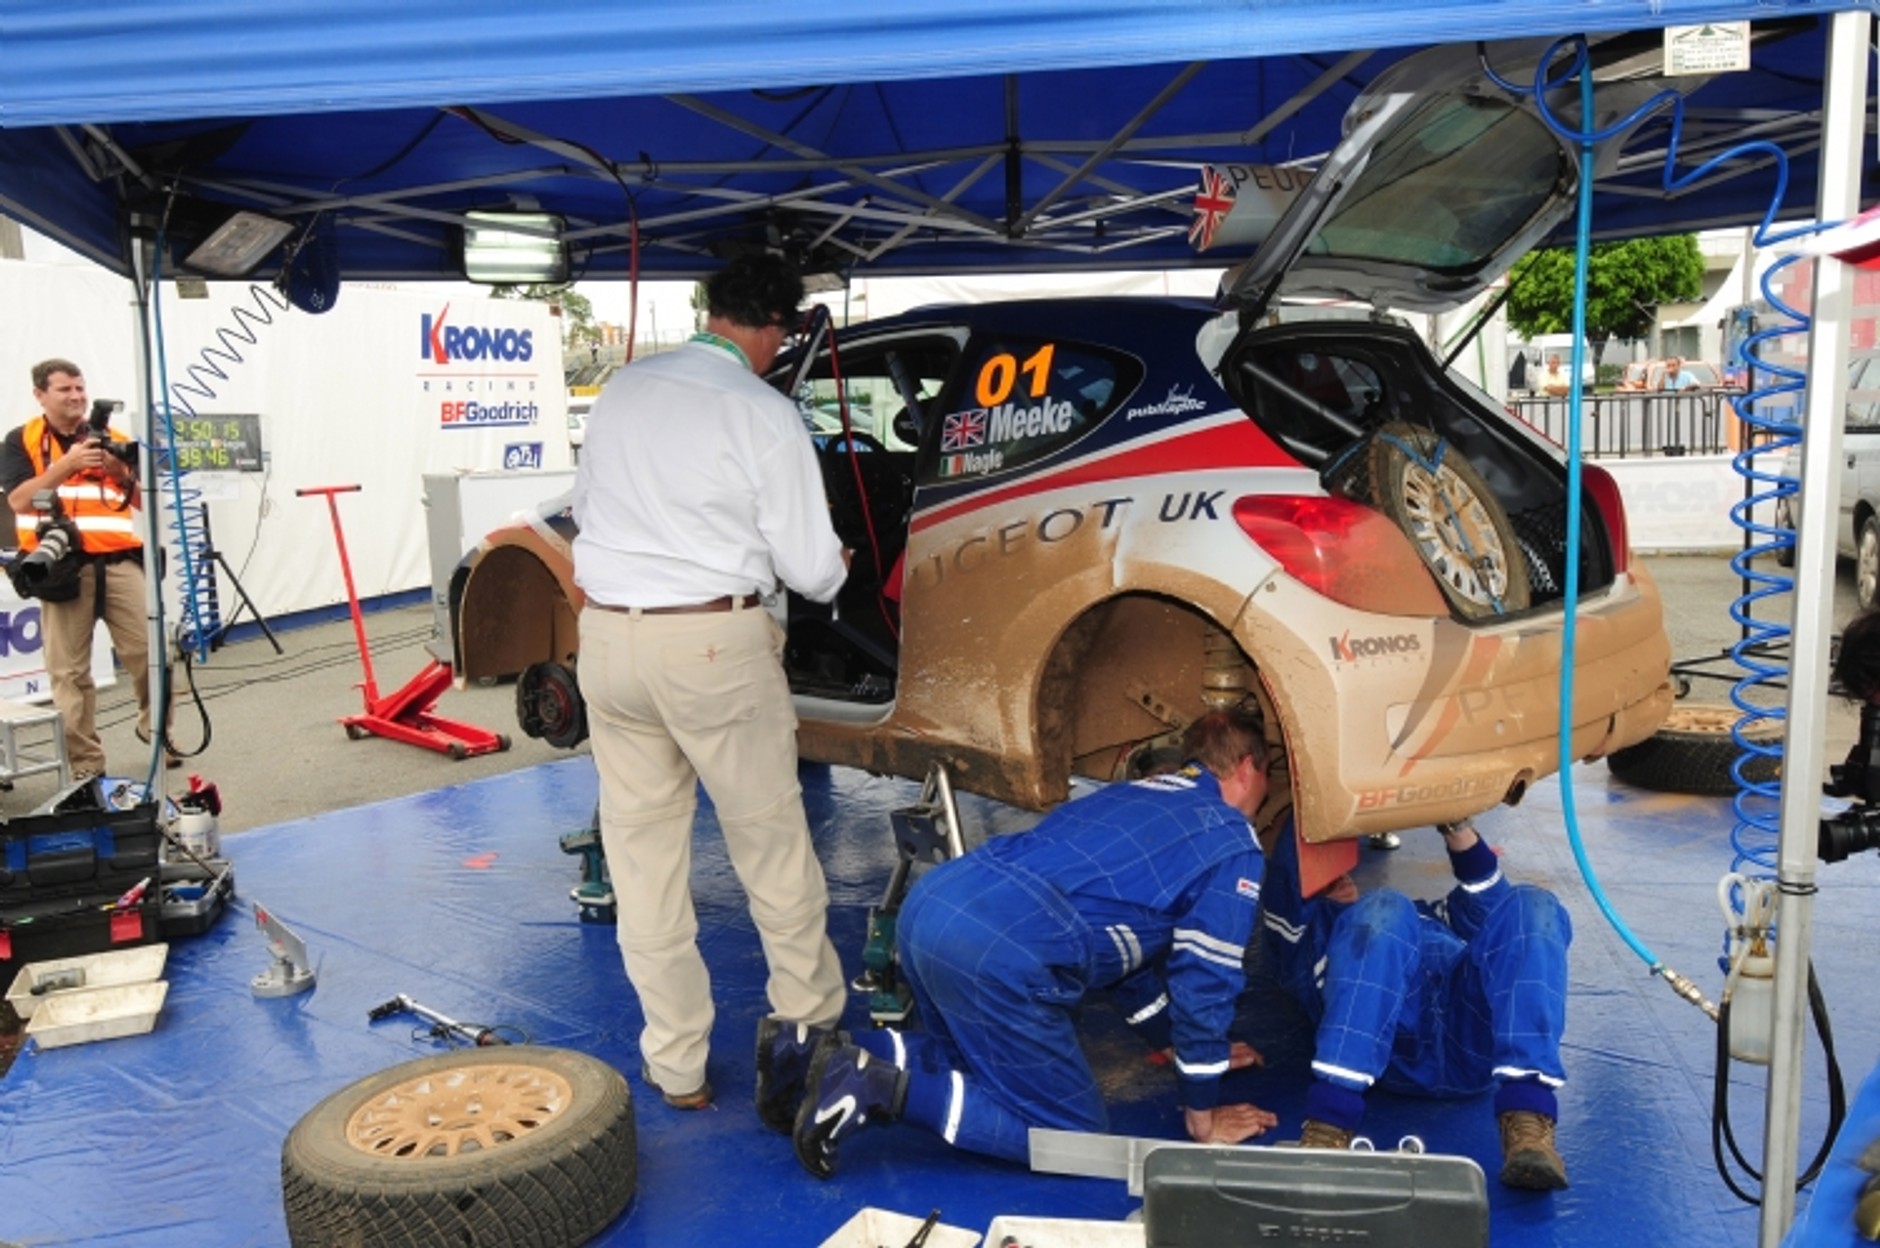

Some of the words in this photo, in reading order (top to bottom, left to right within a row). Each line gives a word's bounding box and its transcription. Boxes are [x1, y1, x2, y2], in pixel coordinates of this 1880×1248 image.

[421, 301, 533, 364] KRONOS
[975, 342, 1056, 408] 01
[441, 401, 538, 423] BFGoodrich
[988, 396, 1072, 444] Meeke
[963, 448, 1004, 474] Nagle
[1157, 489, 1227, 522] UK
[1329, 628, 1420, 663] KRONOS
[1358, 773, 1506, 808] BFGoodrich
